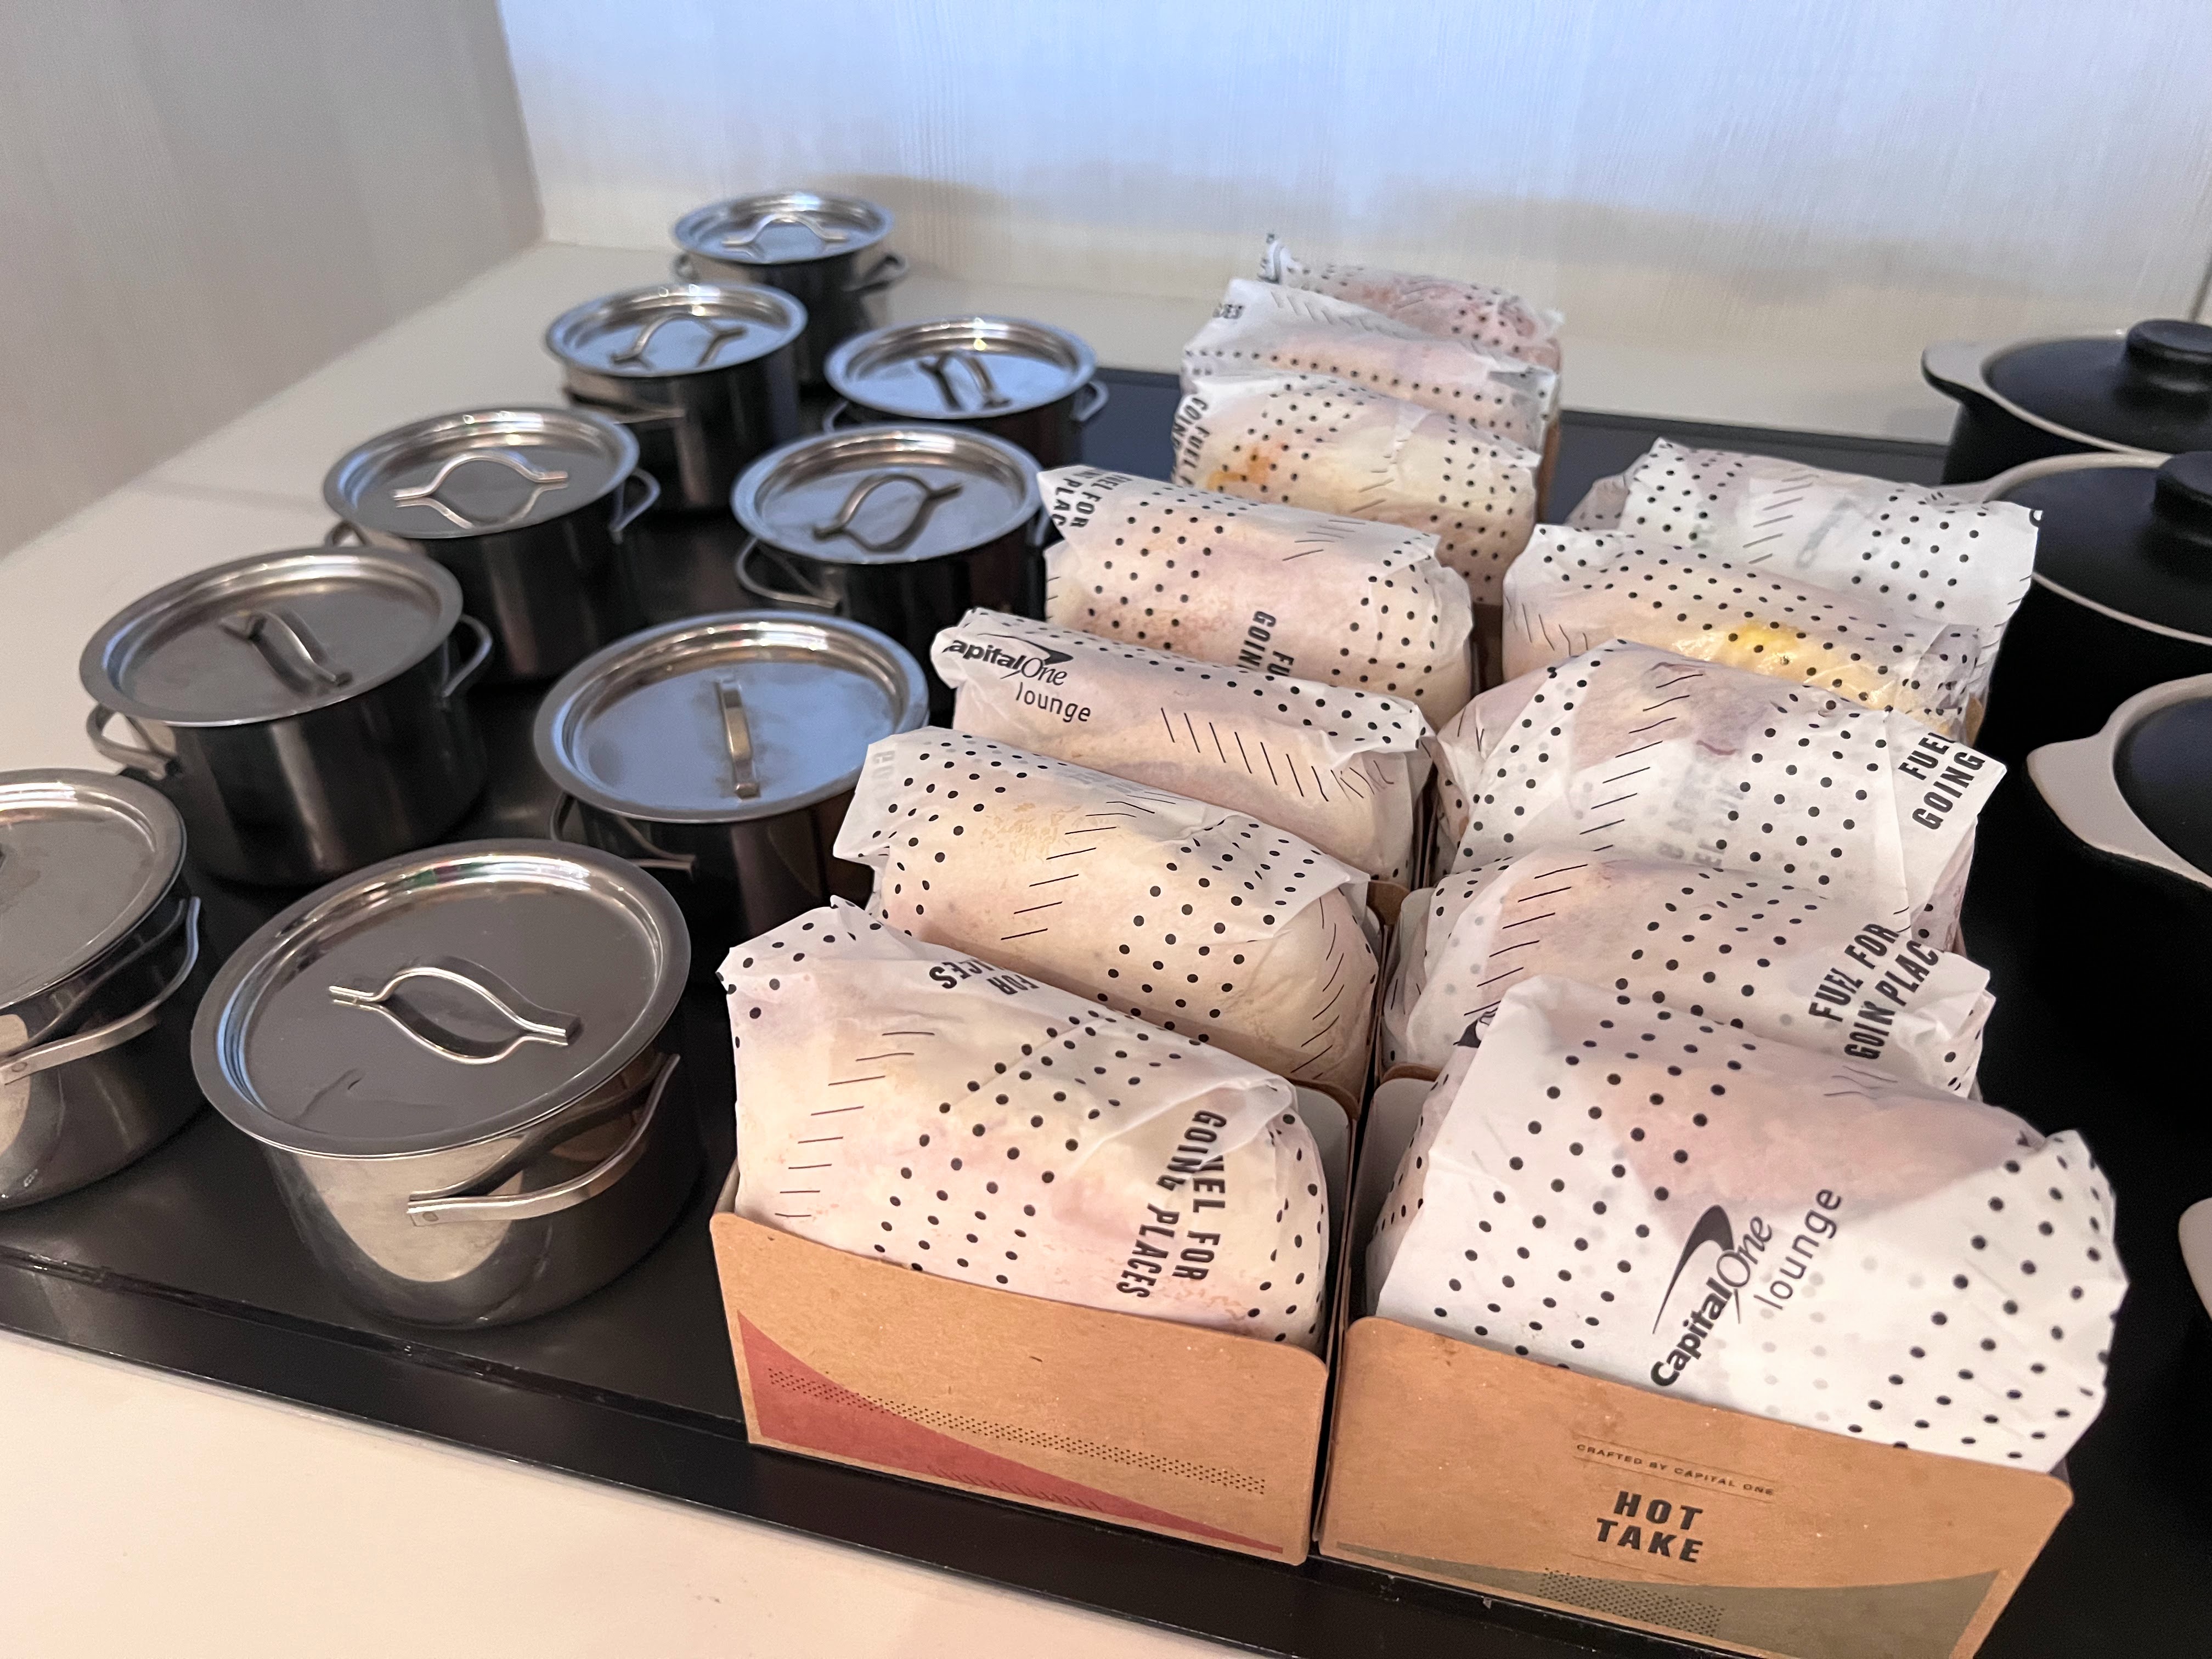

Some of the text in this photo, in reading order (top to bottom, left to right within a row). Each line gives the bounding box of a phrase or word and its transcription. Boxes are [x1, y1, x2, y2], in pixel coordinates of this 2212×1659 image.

[1070, 492, 1102, 527] FOR
[1237, 611, 1276, 672] GOIN
[1015, 681, 1091, 723] lounge
[1912, 752, 1986, 830] GOING
[1844, 923, 1899, 970] FOR
[986, 974, 1040, 995] FOR
[1116, 1203, 1180, 1298] PLACES
[1172, 1230, 1221, 1280] FOR
[1753, 1188, 1842, 1311] lounge
[1577, 1443, 1775, 1496] CRAFTED BY CAPITAL ONE
[1613, 1491, 1704, 1531] HOT
[1596, 1517, 1703, 1563] TAKE
